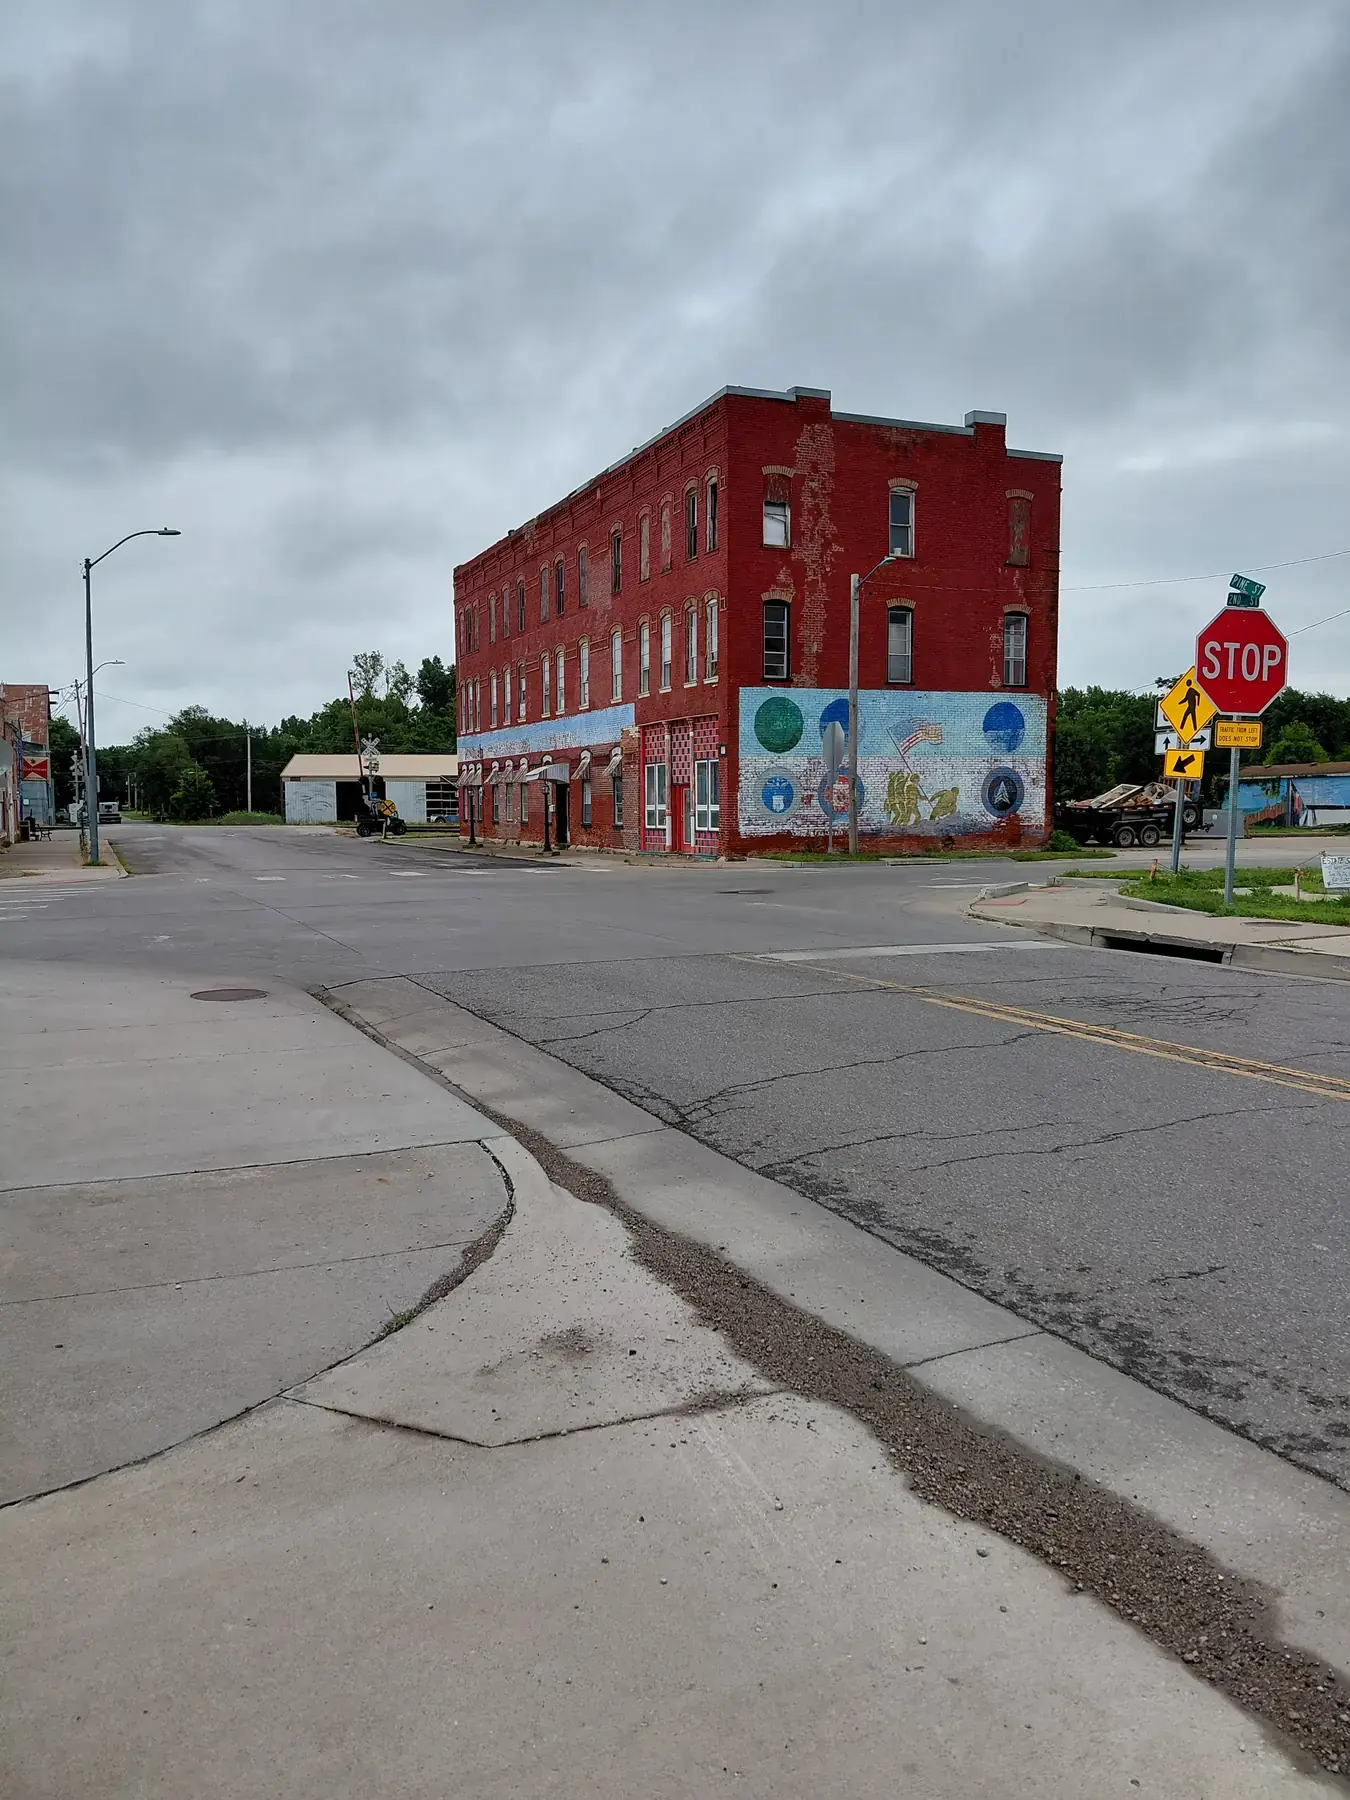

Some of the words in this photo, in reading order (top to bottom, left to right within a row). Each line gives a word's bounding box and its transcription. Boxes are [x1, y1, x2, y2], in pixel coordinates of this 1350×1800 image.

[1231, 575, 1250, 591] PINE
[1252, 584, 1264, 596] ST
[1229, 594, 1242, 605] 2ND
[1202, 640, 1282, 682] STOP
[1322, 856, 1345, 865] ESTATE
